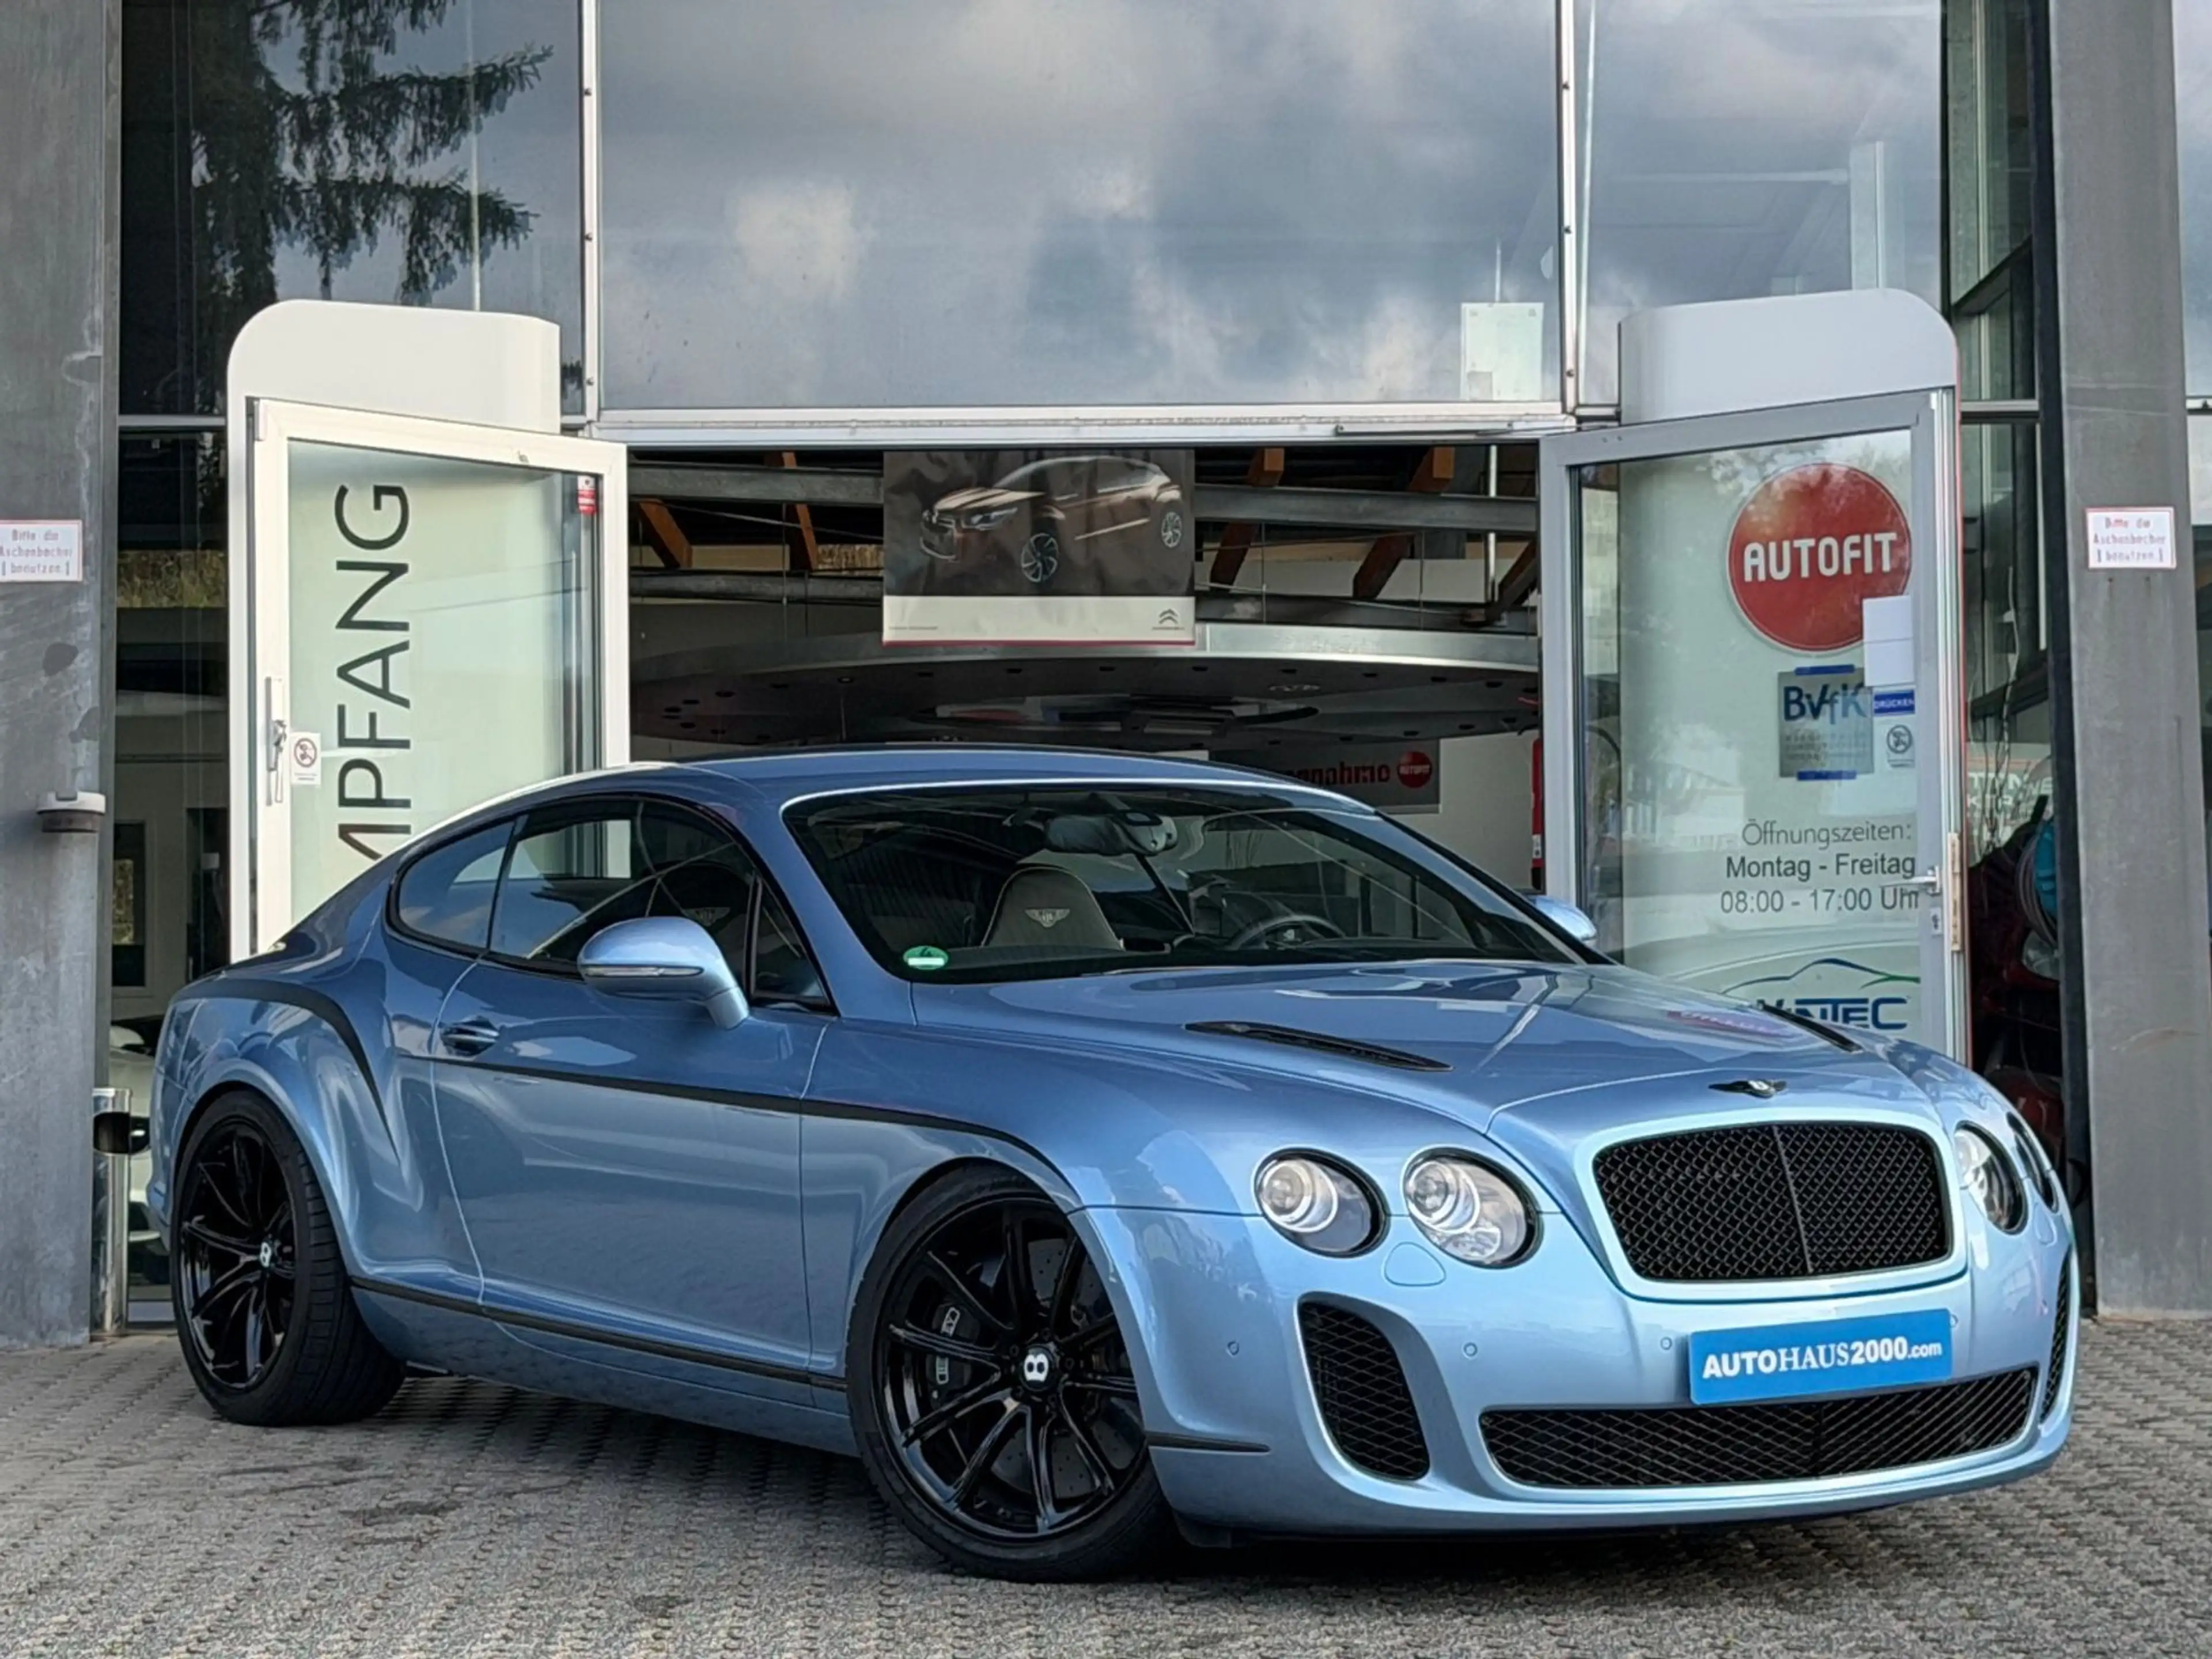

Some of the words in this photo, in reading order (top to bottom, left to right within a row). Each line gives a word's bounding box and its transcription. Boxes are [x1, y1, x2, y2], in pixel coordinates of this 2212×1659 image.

[1744, 532, 1897, 582] AUTOFIT
[1742, 819, 1912, 850] Öffnungszeiten:
[1726, 855, 1811, 882] Montag
[1835, 853, 1916, 880] Freitag
[1721, 890, 1784, 914] 08:00
[1810, 888, 1872, 911] 17:00
[1881, 887, 1919, 910] Uhr
[1702, 1336, 1944, 1379] AUTOHAUS2000.com
